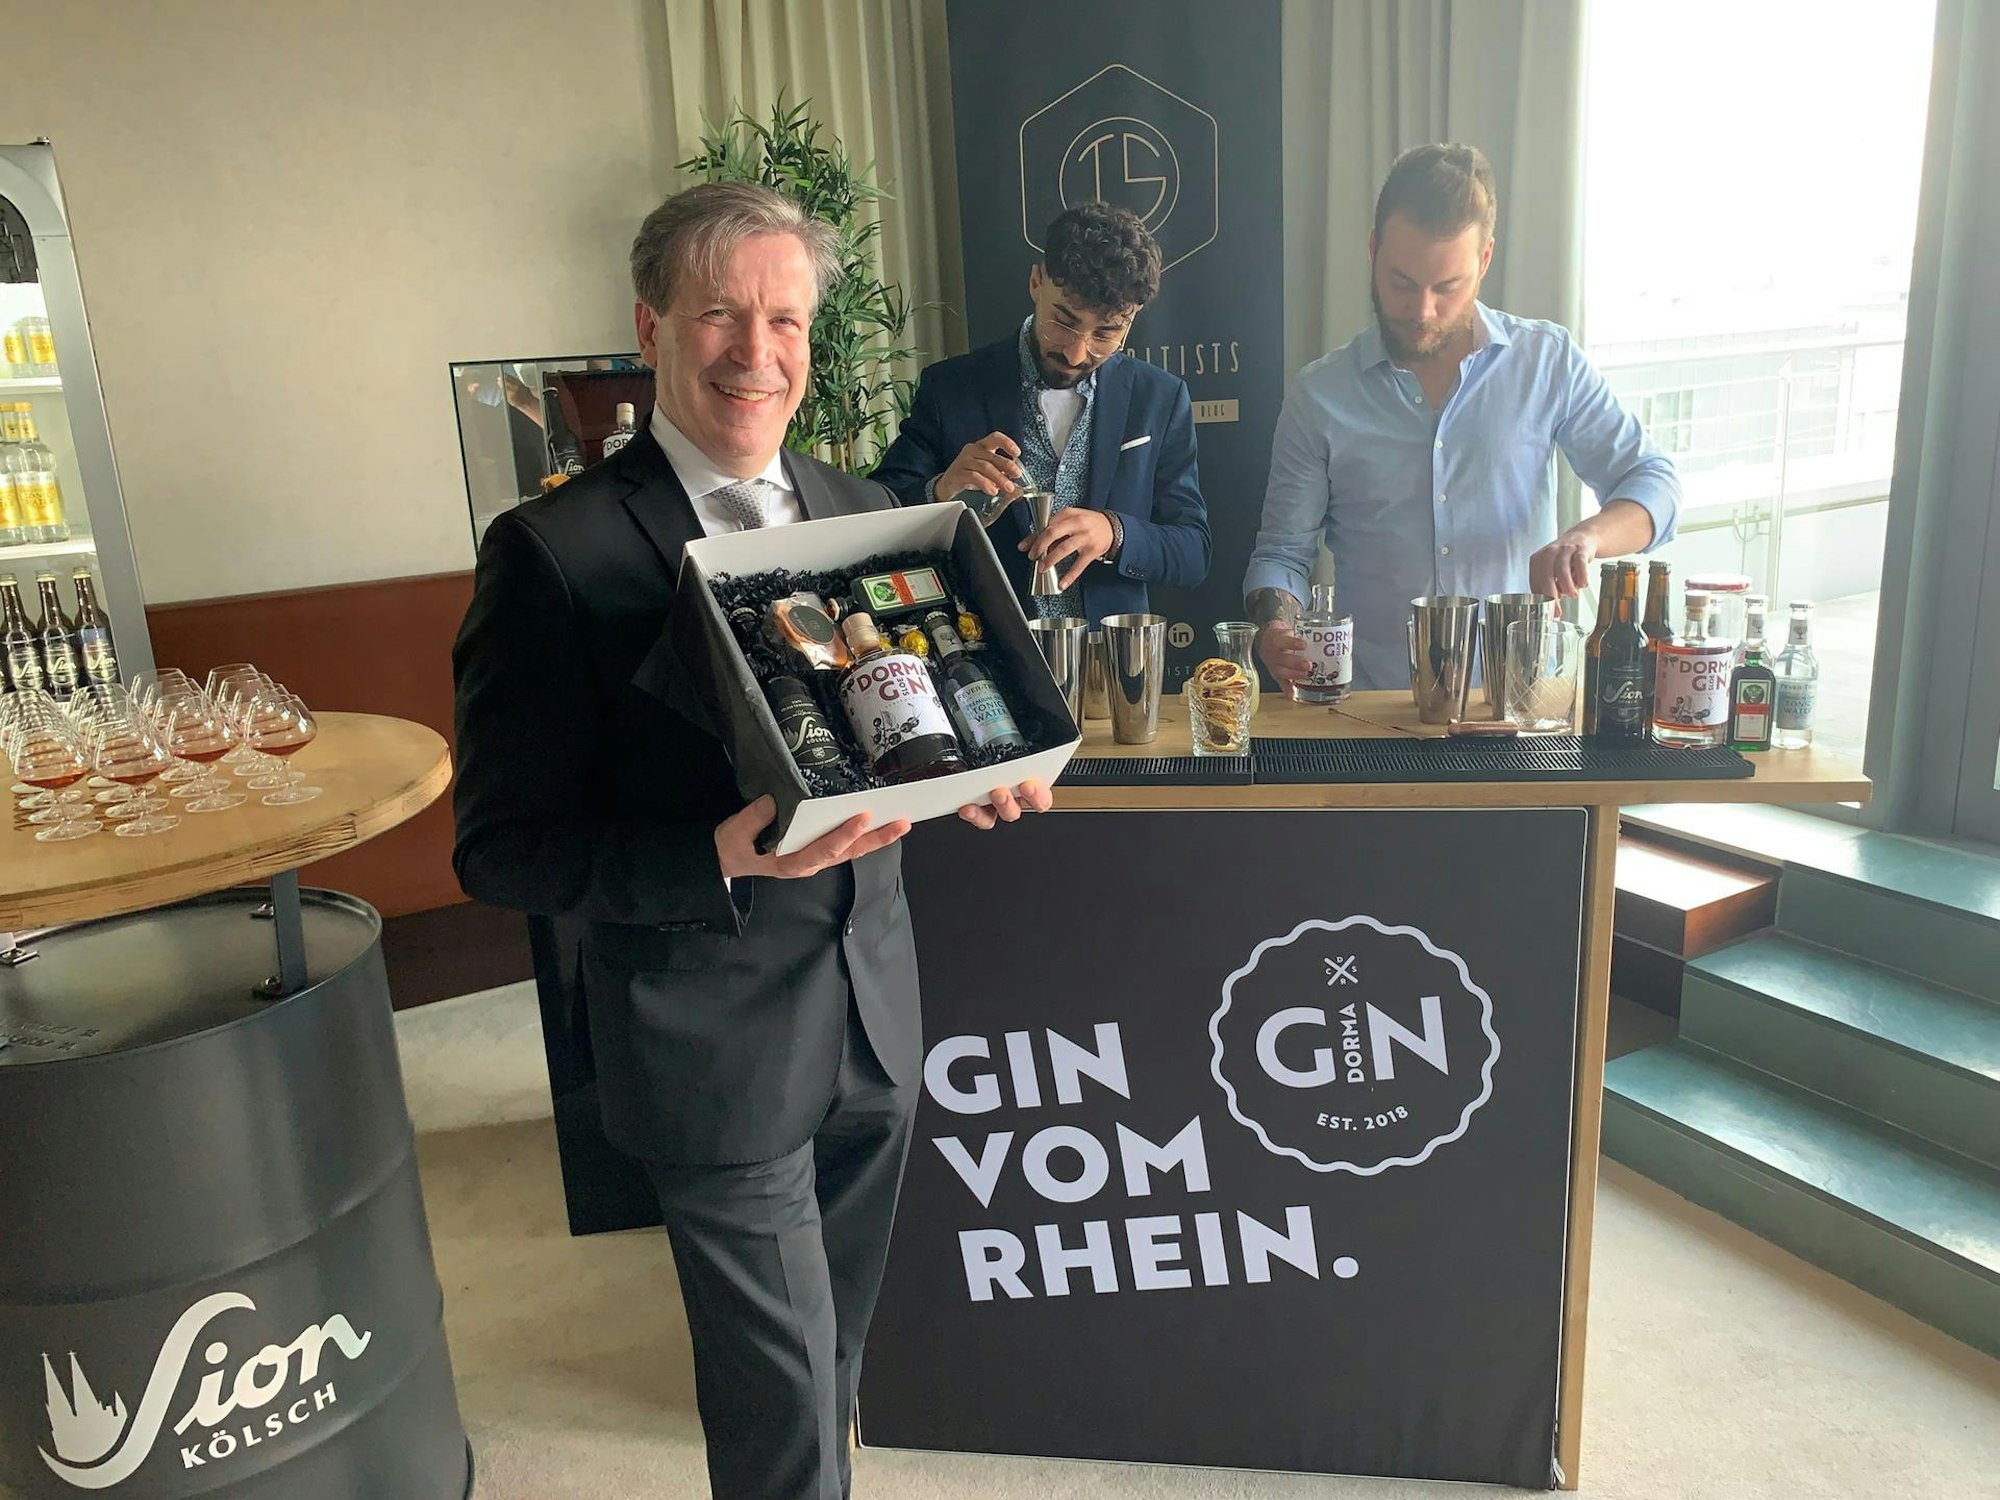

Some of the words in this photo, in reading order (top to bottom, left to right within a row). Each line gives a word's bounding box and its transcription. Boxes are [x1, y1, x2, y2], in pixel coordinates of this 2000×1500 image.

[1602, 681, 1644, 703] Sion
[923, 1022, 1131, 1115] GIN
[1339, 1002, 1365, 1084] DORMA
[932, 1115, 1211, 1210] VOM
[1316, 1112, 1358, 1131] EST.
[1363, 1105, 1409, 1131] 2018
[958, 1205, 1360, 1302] RHEIN.
[37, 1291, 372, 1489] Sion
[180, 1382, 338, 1470] KÖLSCH
